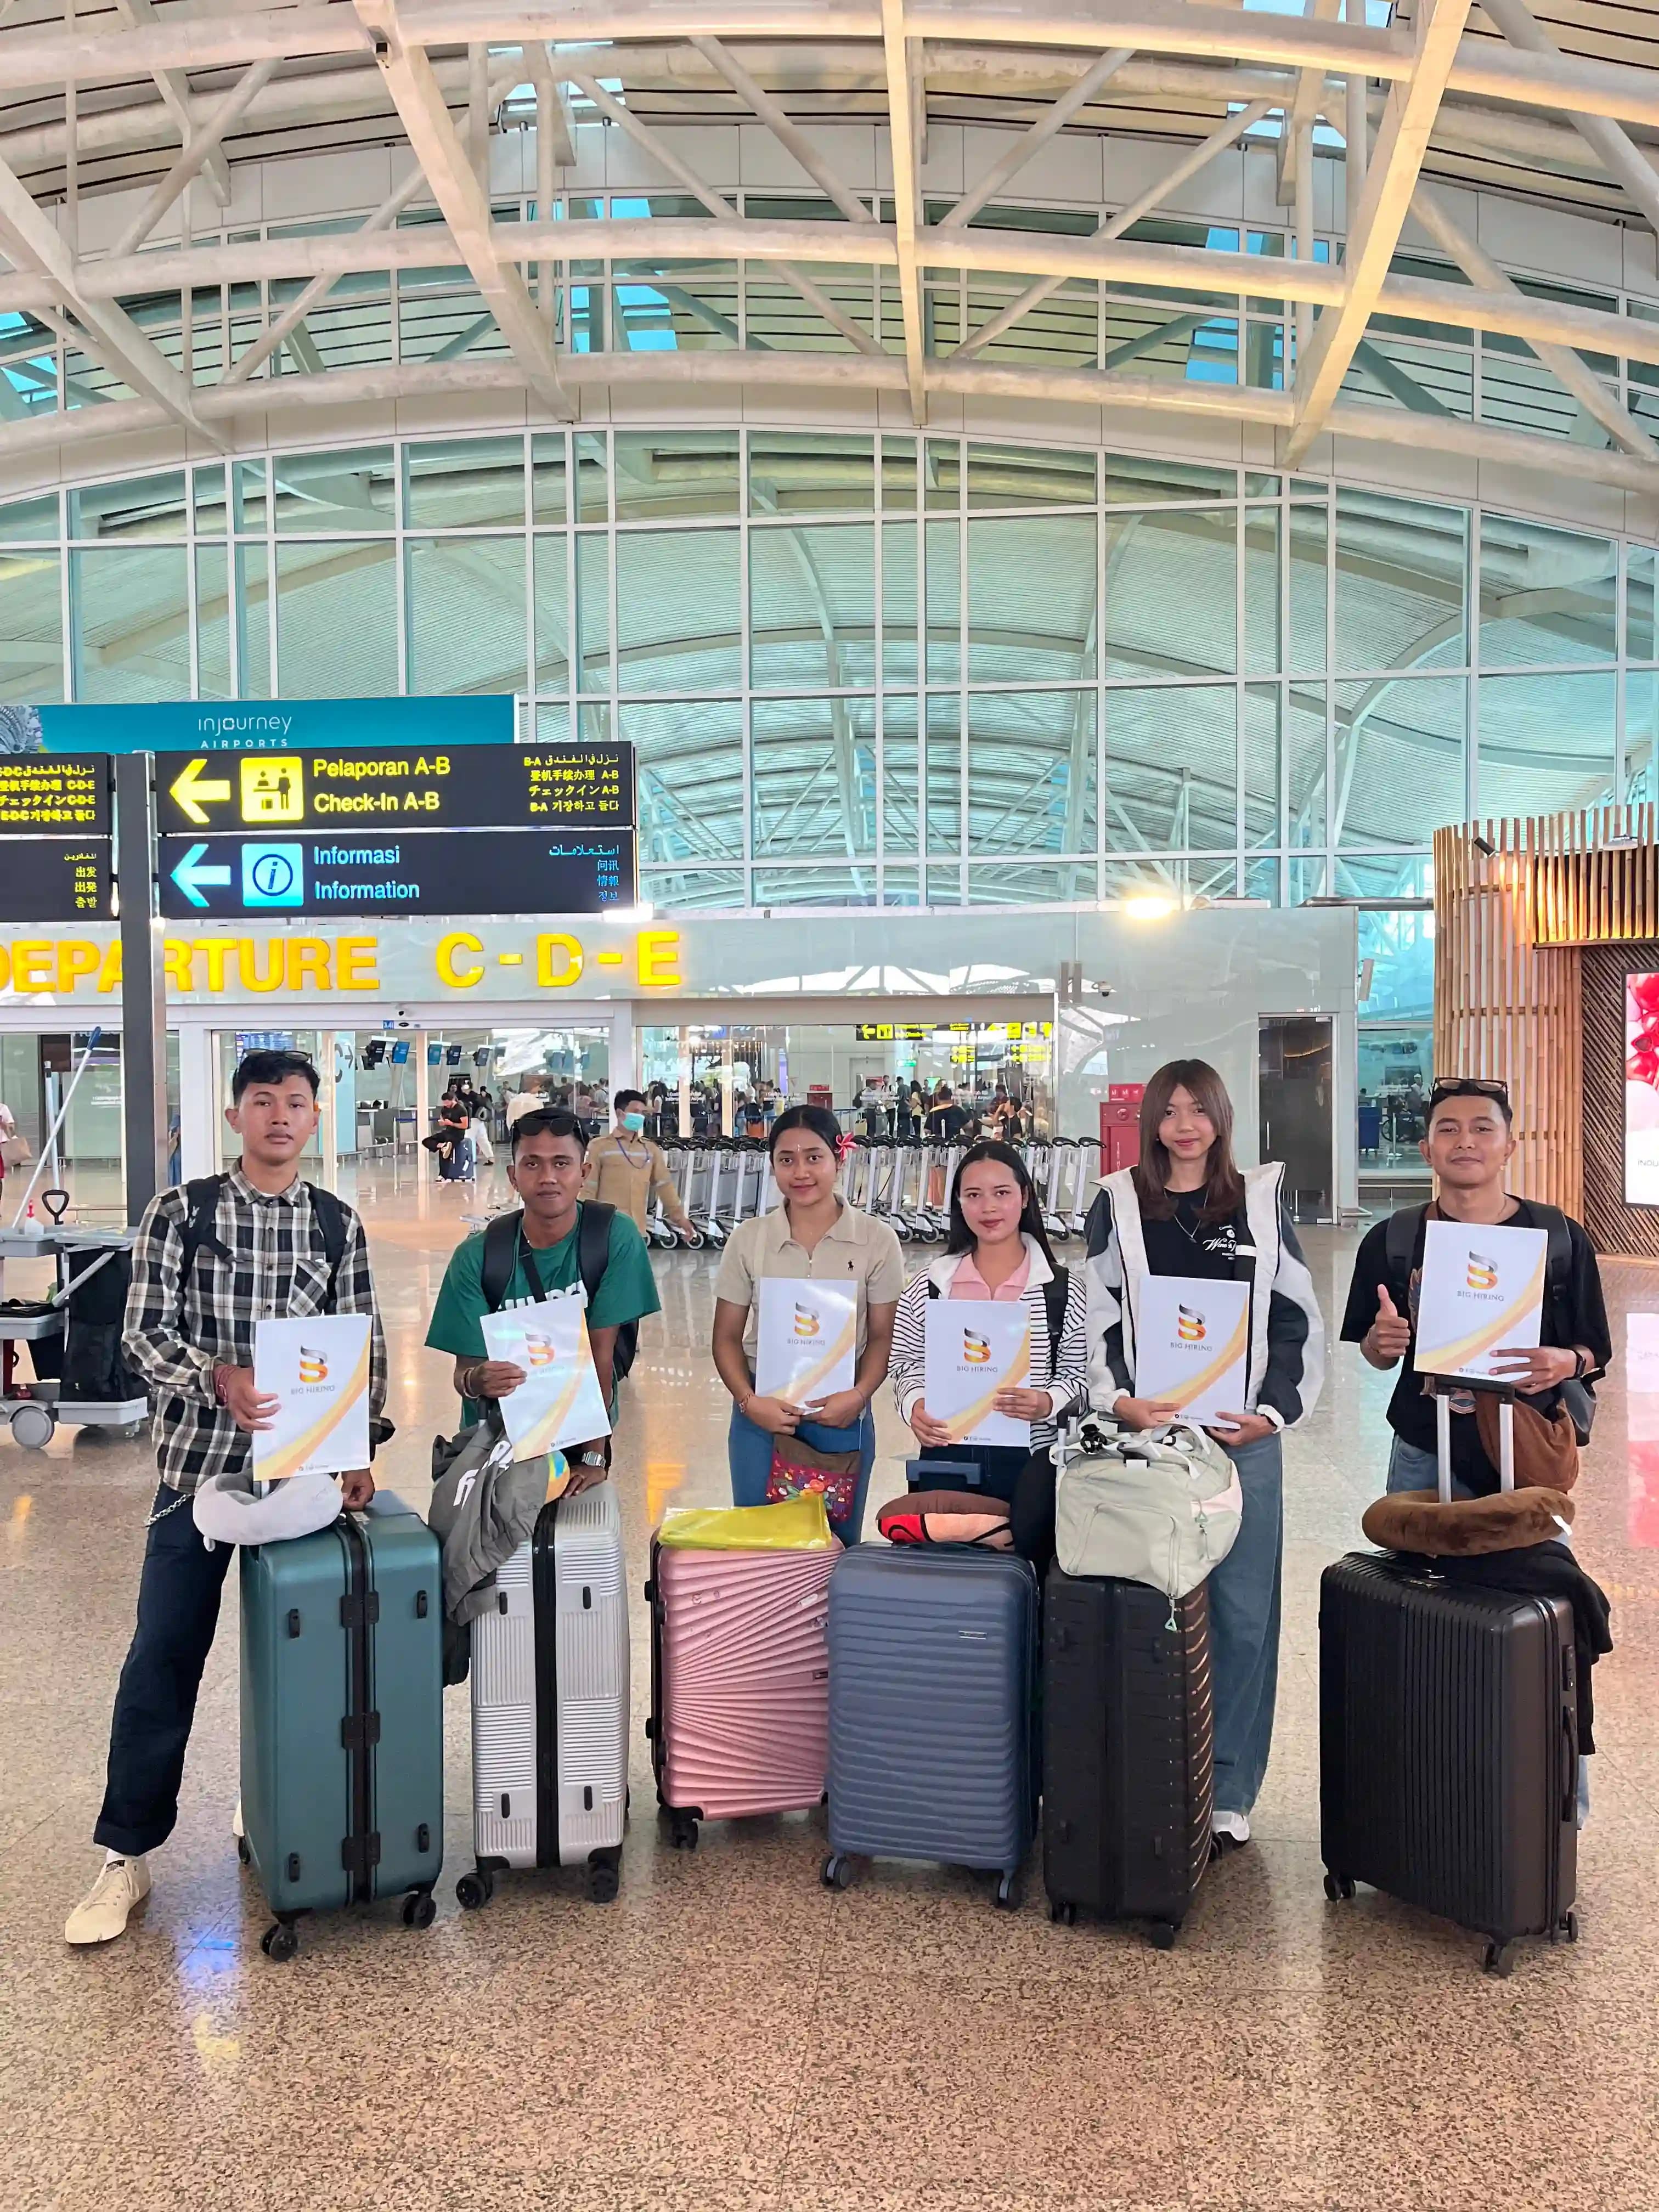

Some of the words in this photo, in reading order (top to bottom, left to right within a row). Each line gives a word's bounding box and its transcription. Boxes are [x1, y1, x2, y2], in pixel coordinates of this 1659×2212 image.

[201, 739, 287, 748] AIRPORTS
[313, 759, 410, 780] Pelaporan
[414, 757, 450, 775] A-B
[601, 770, 619, 780] A-B
[528, 785, 600, 797] チェックイン
[602, 785, 619, 794] A-B
[313, 793, 398, 813] Check-In
[403, 791, 440, 810] A-B
[314, 845, 399, 865] Informasi
[597, 859, 619, 871] 问讯
[75, 866, 97, 878] 出发
[75, 881, 97, 893] 出発
[314, 881, 419, 900] Information
[599, 890, 619, 902] 정보
[75, 896, 98, 909] 출발
[1474, 1293, 1505, 1302] HIRING
[1185, 1343, 1212, 1352] HIRING
